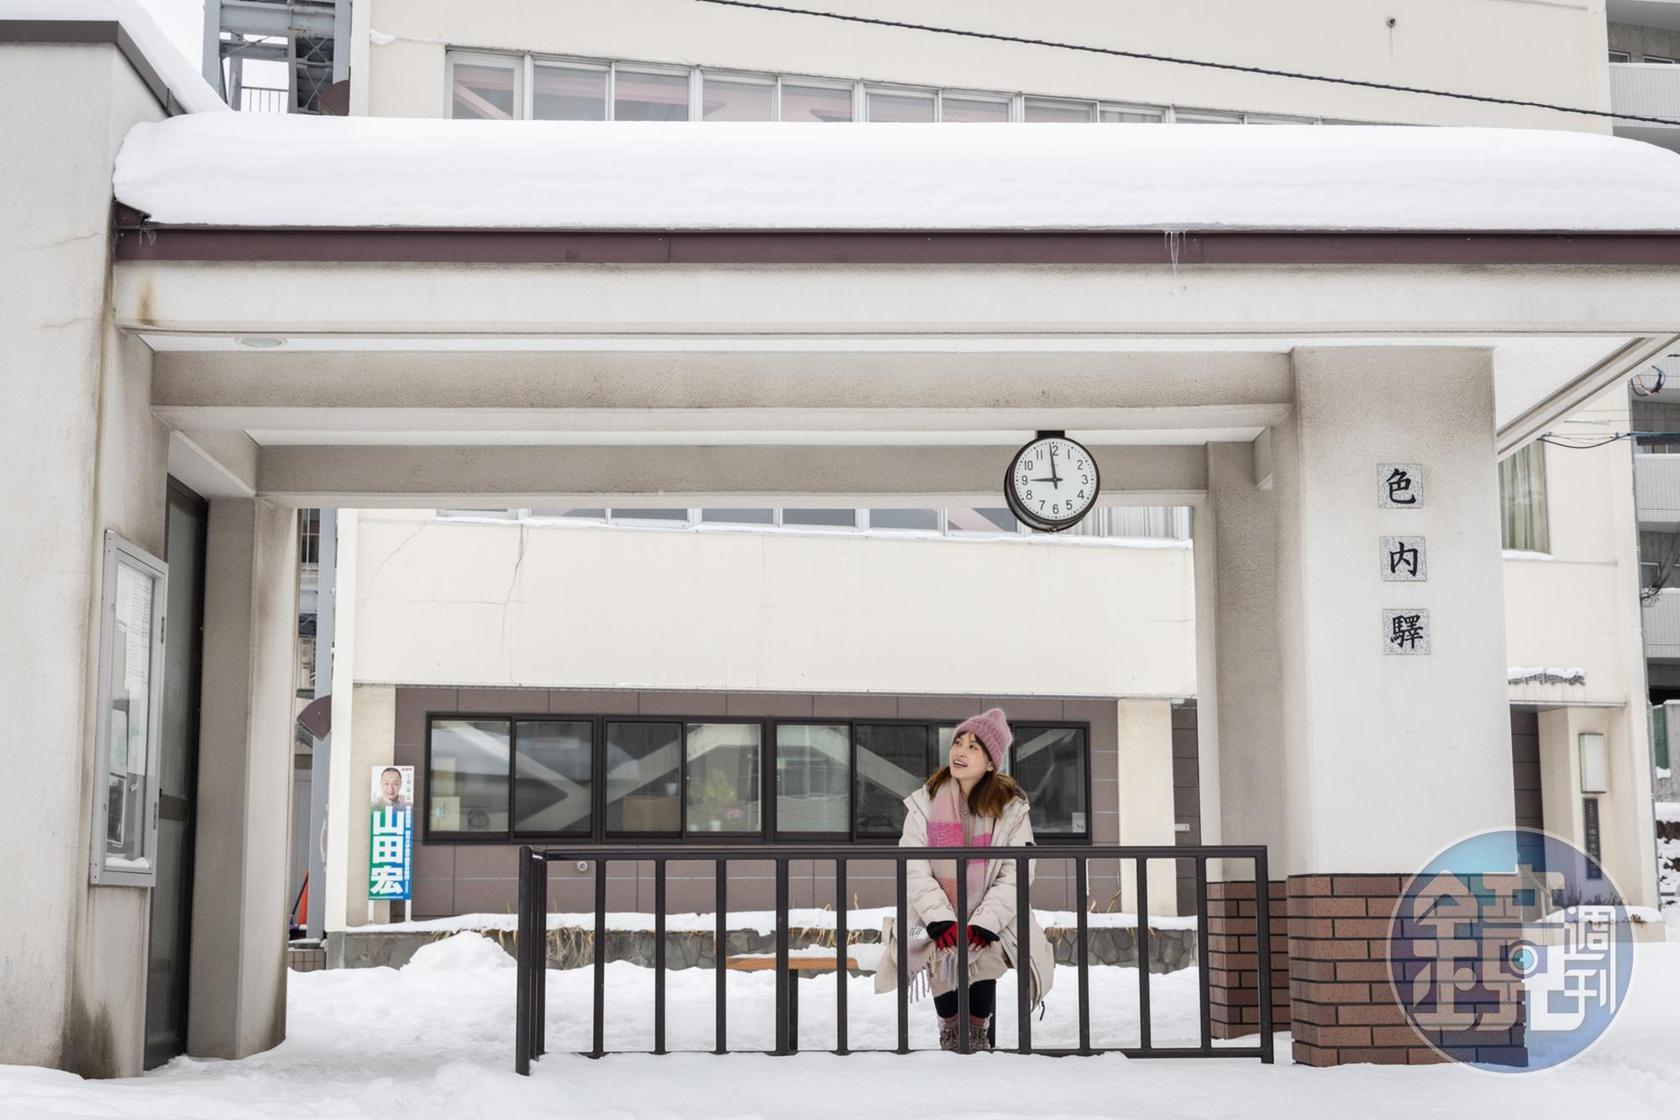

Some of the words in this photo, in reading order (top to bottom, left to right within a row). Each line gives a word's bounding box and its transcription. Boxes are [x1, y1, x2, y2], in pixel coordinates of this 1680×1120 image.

[1036, 449, 1043, 460] 11
[1024, 460, 1033, 471] 10
[1077, 460, 1083, 470] 2
[1021, 475, 1028, 485] 9
[1081, 474, 1088, 485] 3
[1026, 490, 1033, 500] 8
[1077, 489, 1085, 500] 4
[1039, 500, 1046, 511] 7
[1052, 504, 1059, 514] 6
[1066, 500, 1073, 510] 5
[1386, 468, 1423, 649] 色内驛
[370, 805, 404, 895] 山田宏
